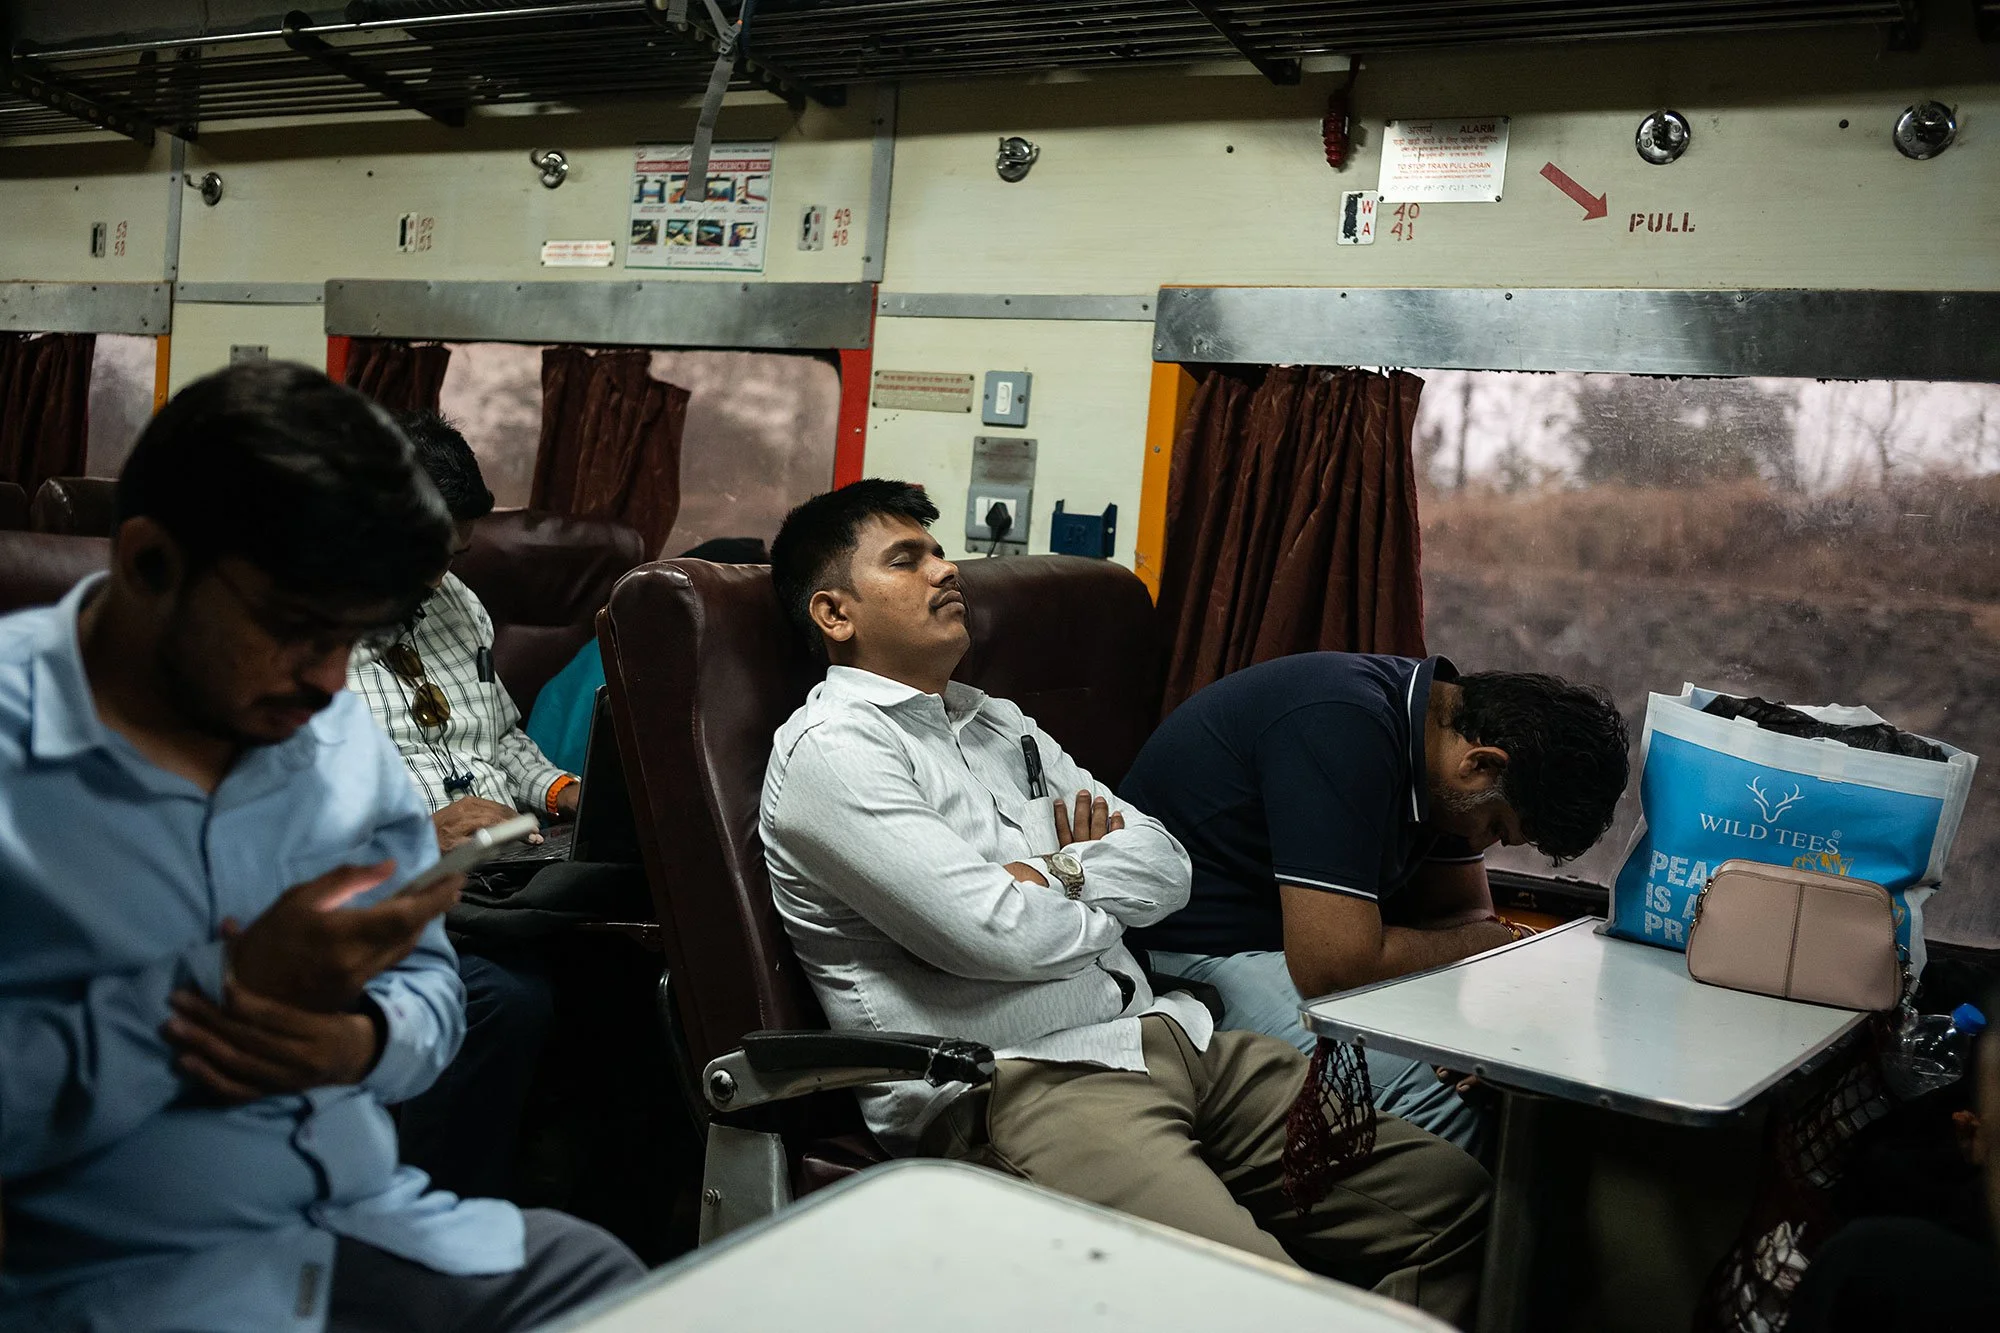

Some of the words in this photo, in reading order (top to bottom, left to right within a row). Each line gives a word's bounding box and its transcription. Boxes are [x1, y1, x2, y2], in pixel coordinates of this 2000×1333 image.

[1460, 124, 1496, 134] ALARM
[1469, 161, 1492, 169] CHAIN
[1361, 200, 1375, 215] W
[1393, 202, 1420, 221] 40
[833, 208, 851, 228] 49
[1629, 212, 1696, 233] PULL
[832, 228, 848, 247] 48
[1361, 222, 1371, 236] A
[1390, 222, 1414, 242] 41
[1700, 812, 1768, 840] WILD
[1645, 882, 1672, 913] IS
[1644, 911, 1684, 944] PR
